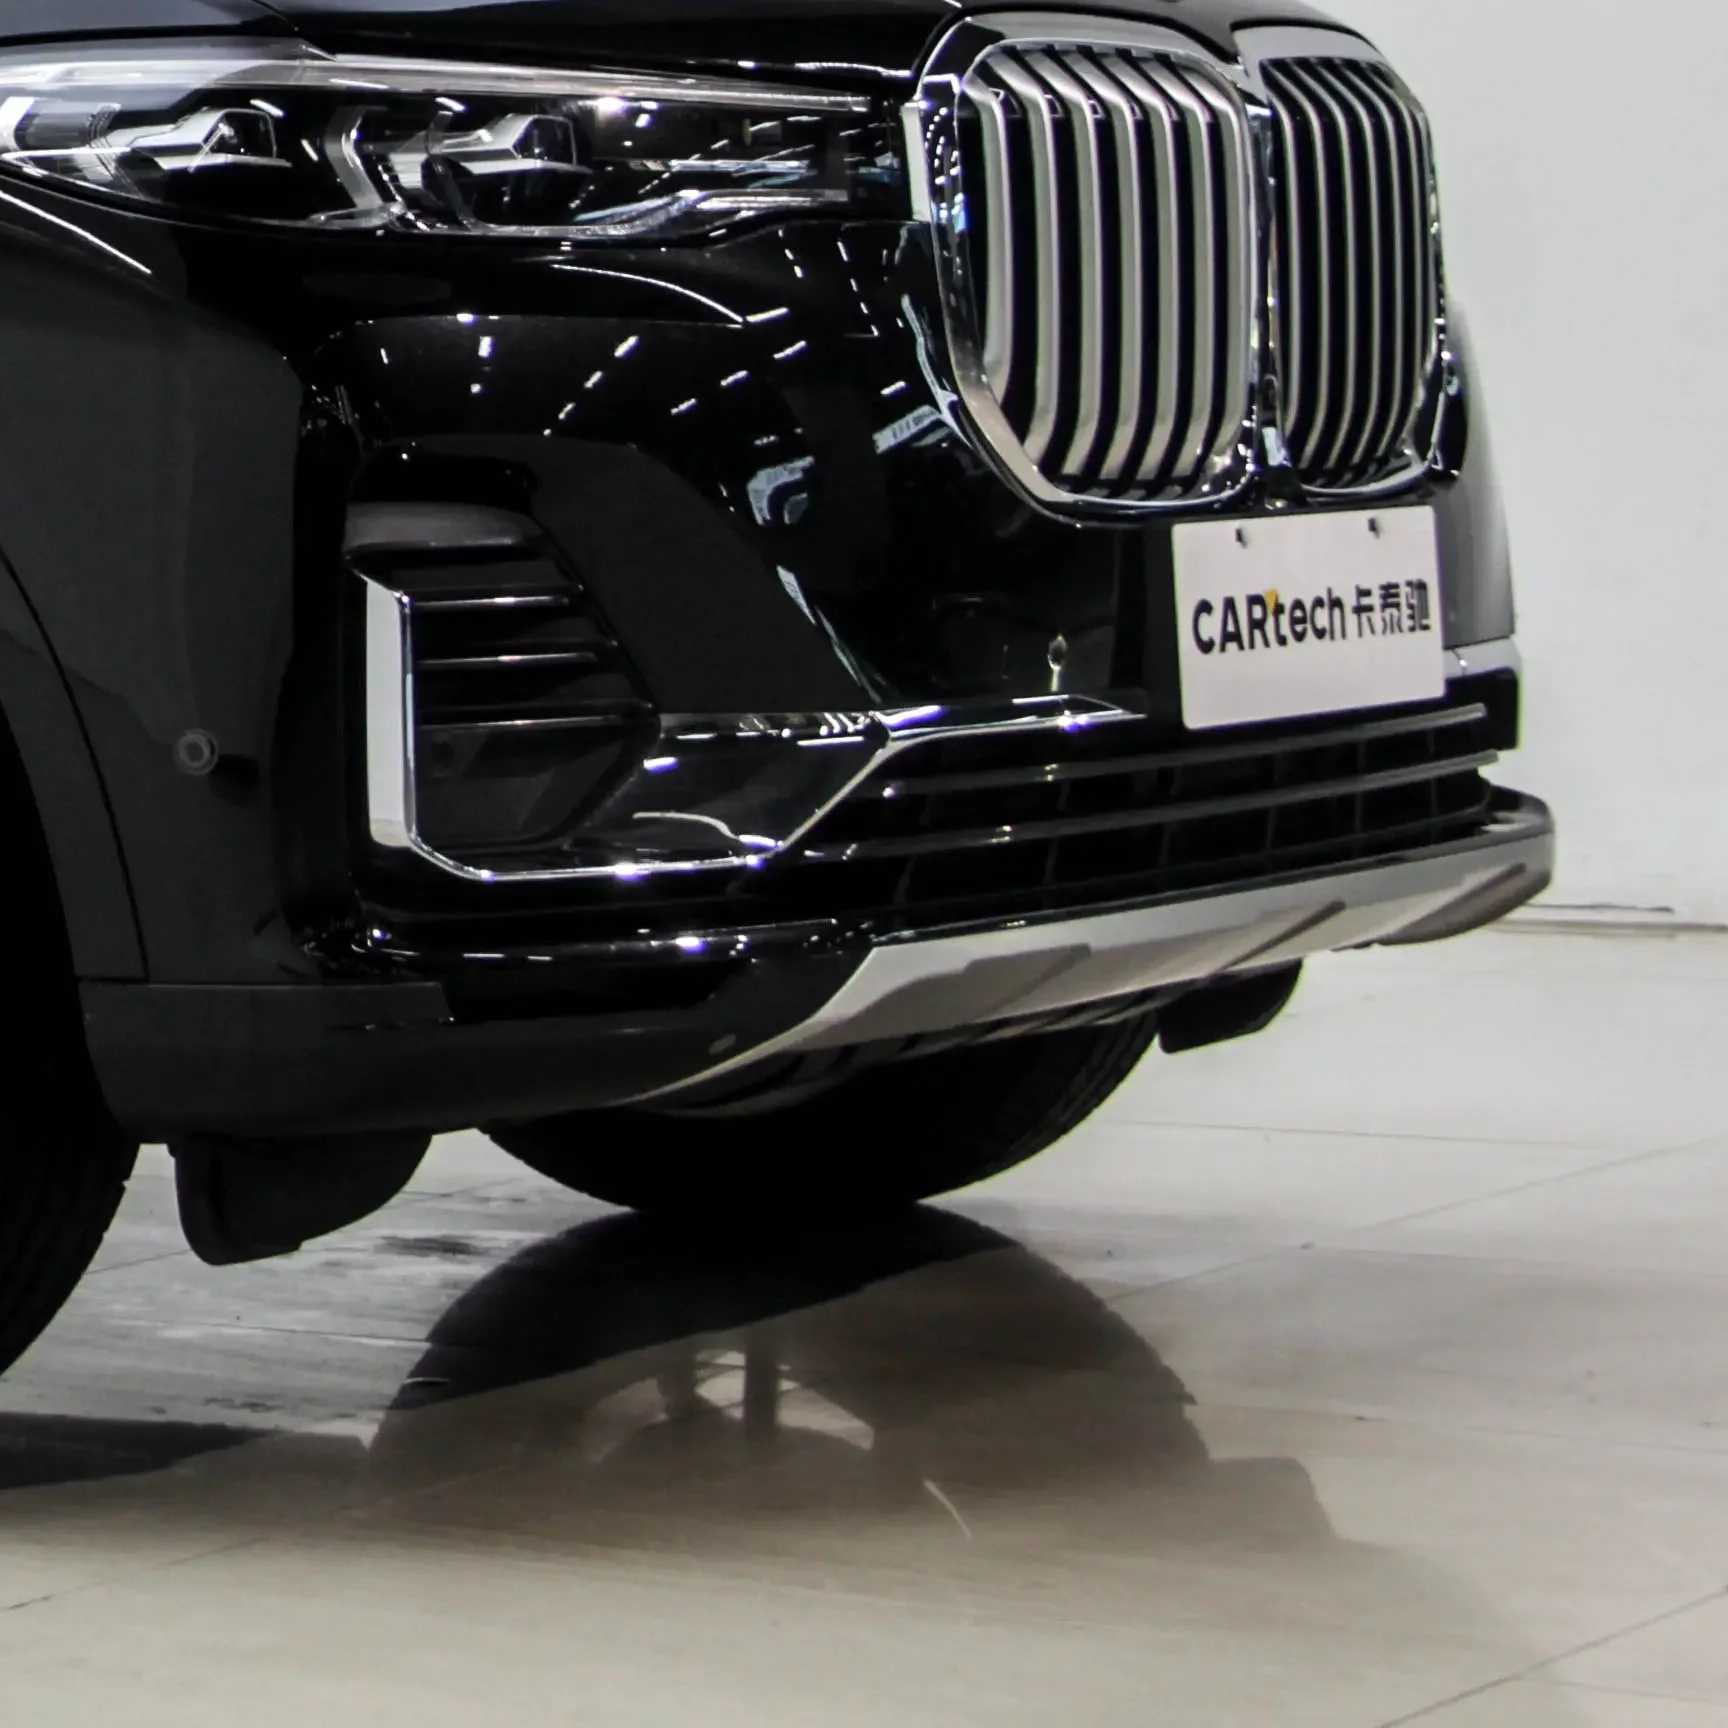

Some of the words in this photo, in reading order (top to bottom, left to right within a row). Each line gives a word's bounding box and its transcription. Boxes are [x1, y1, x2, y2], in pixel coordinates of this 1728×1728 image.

[1192, 585, 1346, 655] CARtech
[1351, 578, 1432, 639] 卡泰驰
